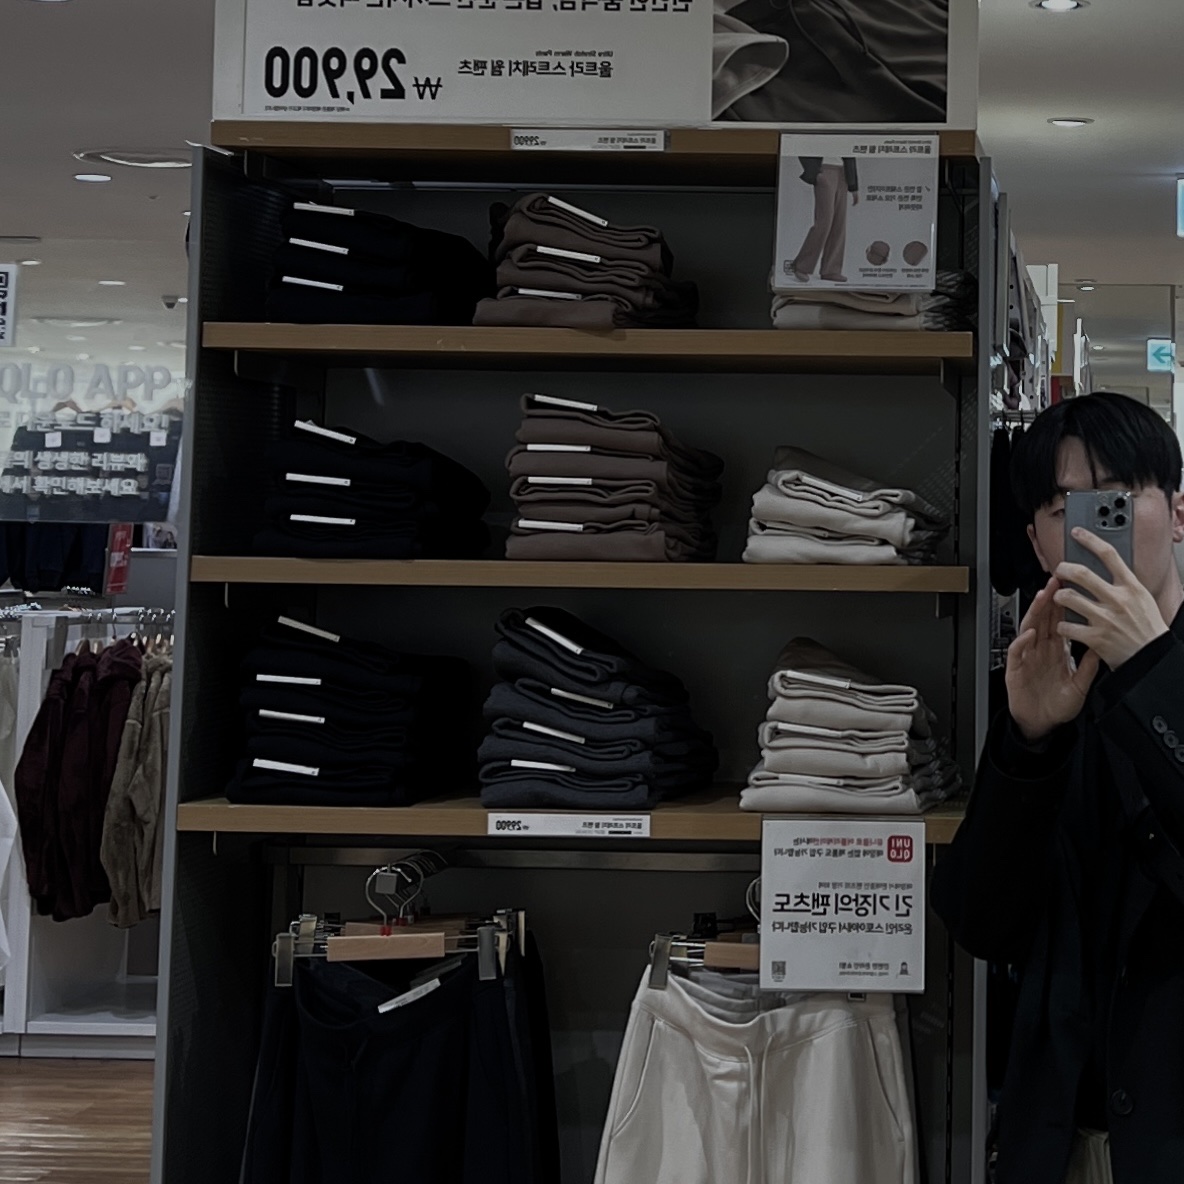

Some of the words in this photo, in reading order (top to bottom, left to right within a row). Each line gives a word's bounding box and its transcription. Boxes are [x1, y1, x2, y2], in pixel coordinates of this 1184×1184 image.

[85, 362, 173, 402] APP
[34, 450, 91, 471] 생생한
[91, 451, 149, 472] 리뷰와
[32, 475, 141, 496] 확인해보세요
